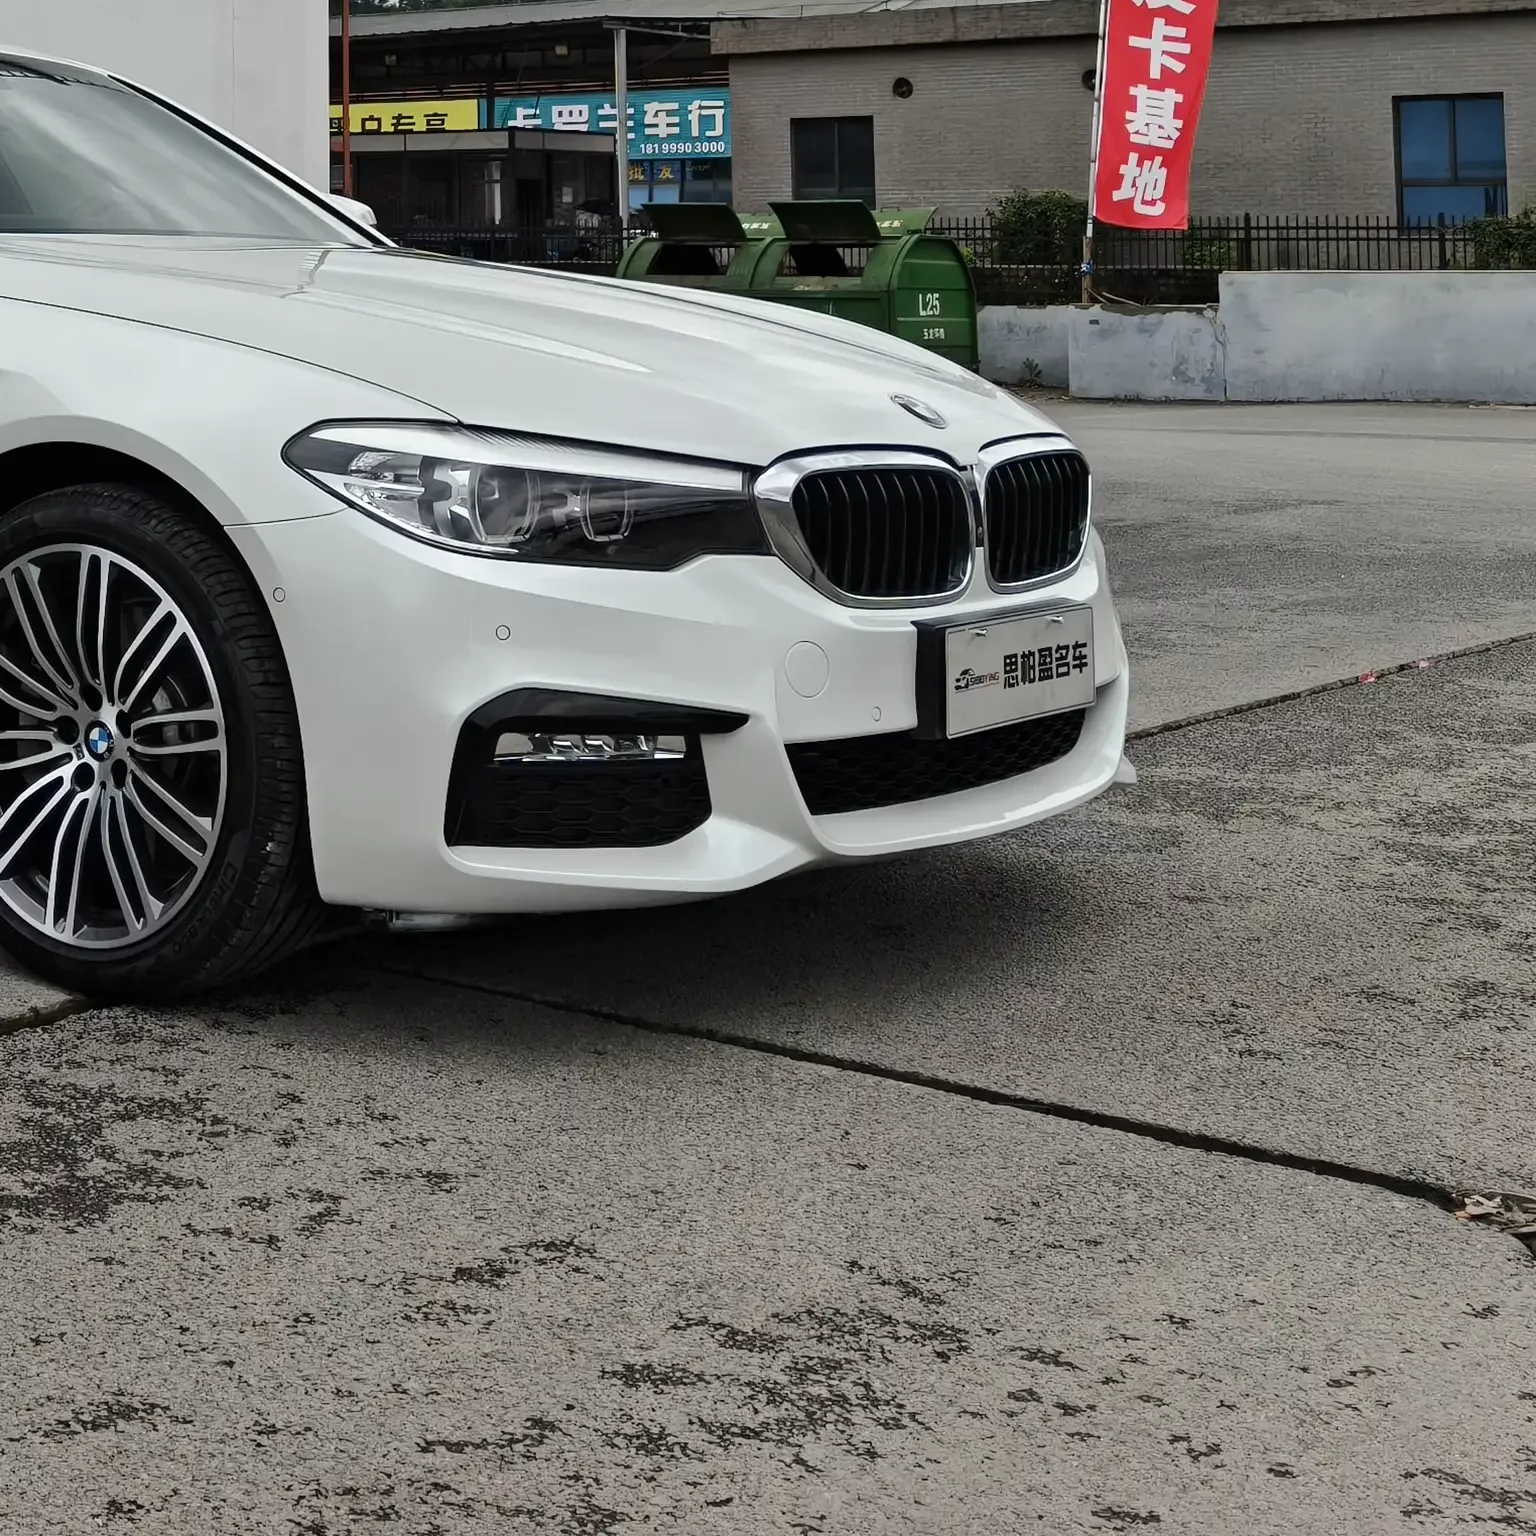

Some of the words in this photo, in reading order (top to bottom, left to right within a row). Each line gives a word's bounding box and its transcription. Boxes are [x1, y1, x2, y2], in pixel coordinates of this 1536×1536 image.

[639, 143, 659, 154] 181
[661, 142, 692, 154] 9990
[694, 141, 725, 154] 3000
[919, 293, 940, 316] L25
